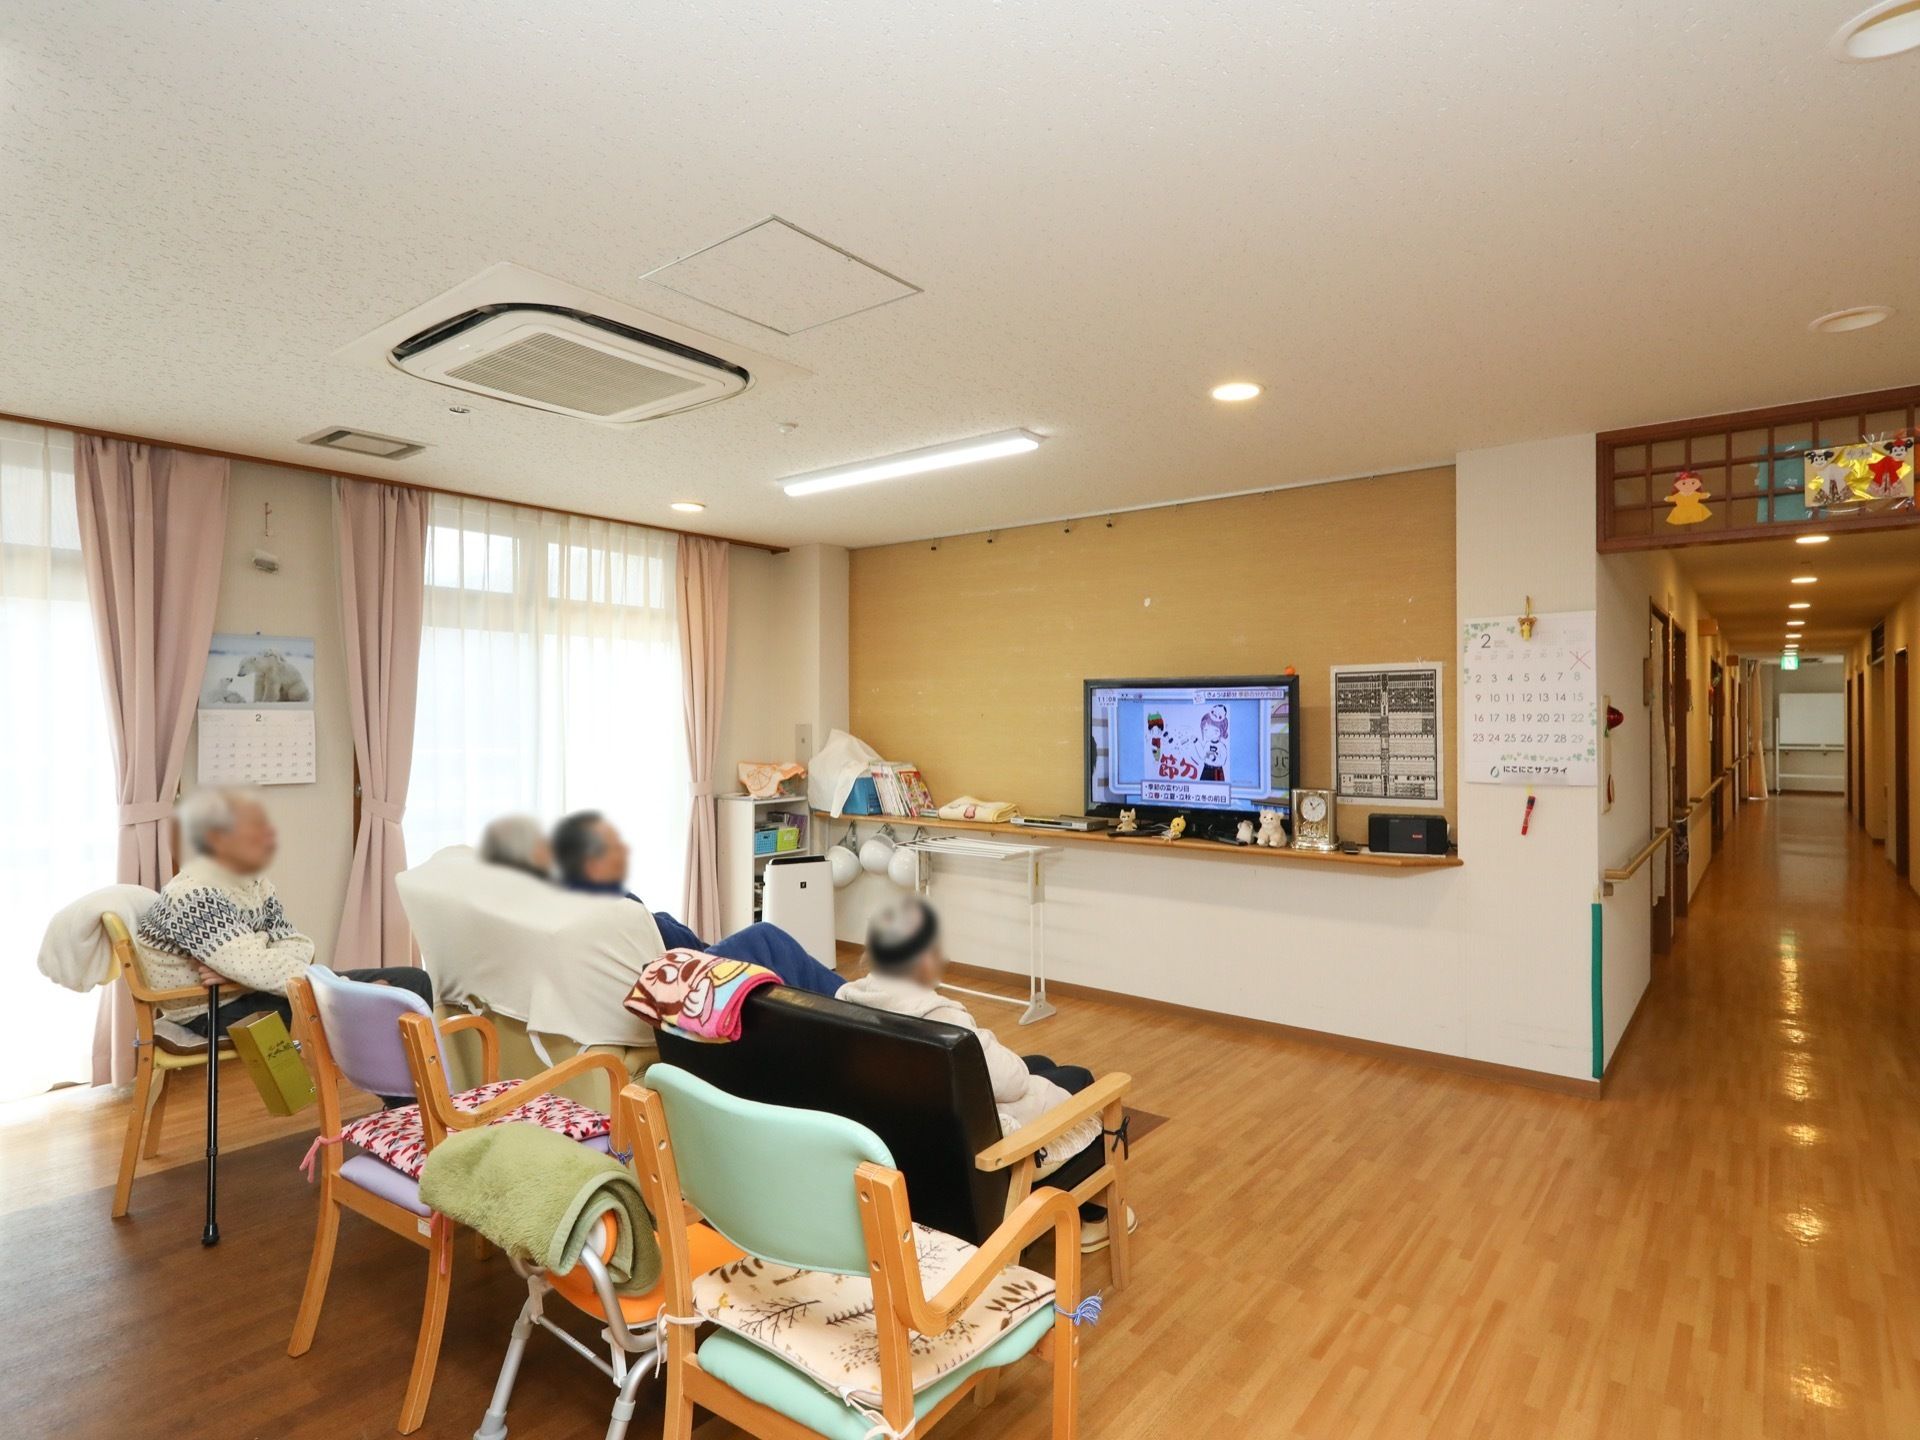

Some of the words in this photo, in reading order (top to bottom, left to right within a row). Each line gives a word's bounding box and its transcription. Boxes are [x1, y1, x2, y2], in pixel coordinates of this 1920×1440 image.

[1480, 633, 1491, 649] 2
[1475, 674, 1482, 683] 2
[1491, 674, 1498, 683] 3
[1507, 674, 1513, 682] 4
[1524, 673, 1530, 682] 5
[1540, 673, 1546, 682] 6
[1557, 672, 1563, 681] 7
[1574, 672, 1581, 681] 8
[1475, 694, 1481, 703] 9
[1490, 694, 1500, 703] 10
[1506, 694, 1515, 703] 11
[1522, 693, 1533, 703] 12
[1539, 693, 1549, 702] 13
[1556, 693, 1566, 702] 14
[1573, 693, 1584, 702] 15
[256, 714, 262, 722] 2
[1474, 714, 1484, 722] 16
[1490, 714, 1500, 722] 17
[1506, 714, 1516, 723] 18
[1522, 714, 1532, 722] 19
[1537, 714, 1550, 723] 20
[1554, 714, 1565, 723] 21
[1571, 714, 1584, 723] 22
[1473, 734, 1484, 742] 23
[1488, 734, 1500, 742] 24
[1504, 734, 1516, 742] 25
[1521, 734, 1533, 743] 26
[1537, 734, 1549, 743] 27
[1554, 734, 1567, 743] 28
[1571, 735, 1584, 743] 29
[1159, 754, 1198, 780] 節分
